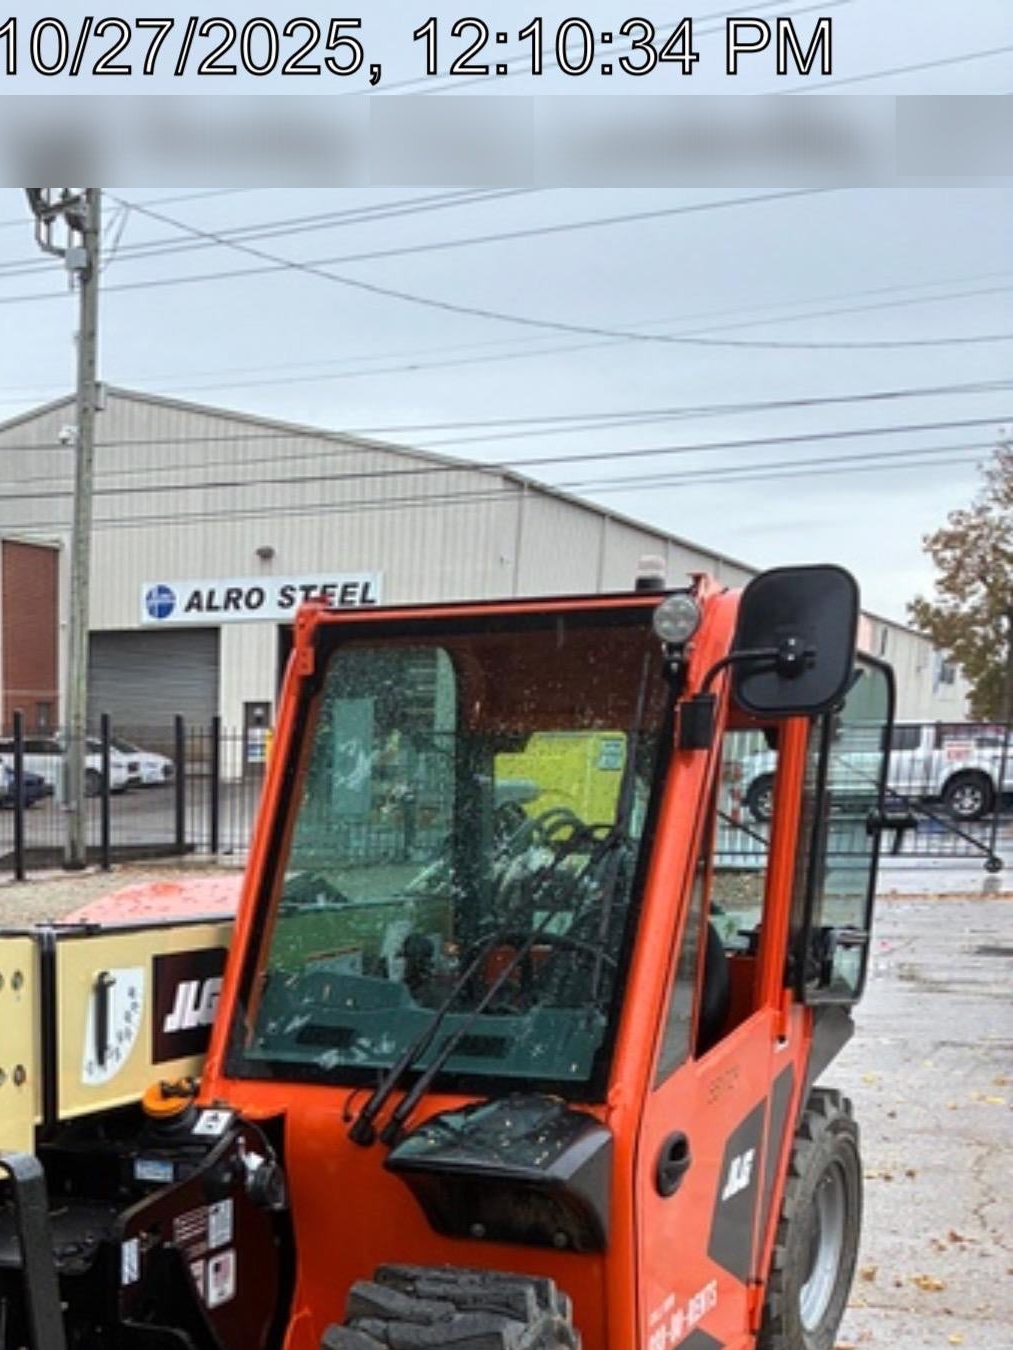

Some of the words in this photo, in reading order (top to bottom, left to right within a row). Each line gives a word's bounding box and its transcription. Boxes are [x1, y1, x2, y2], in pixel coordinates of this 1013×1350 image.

[184, 586, 266, 613] ALRO
[277, 581, 377, 608] STEEL
[163, 976, 224, 1033] JLG
